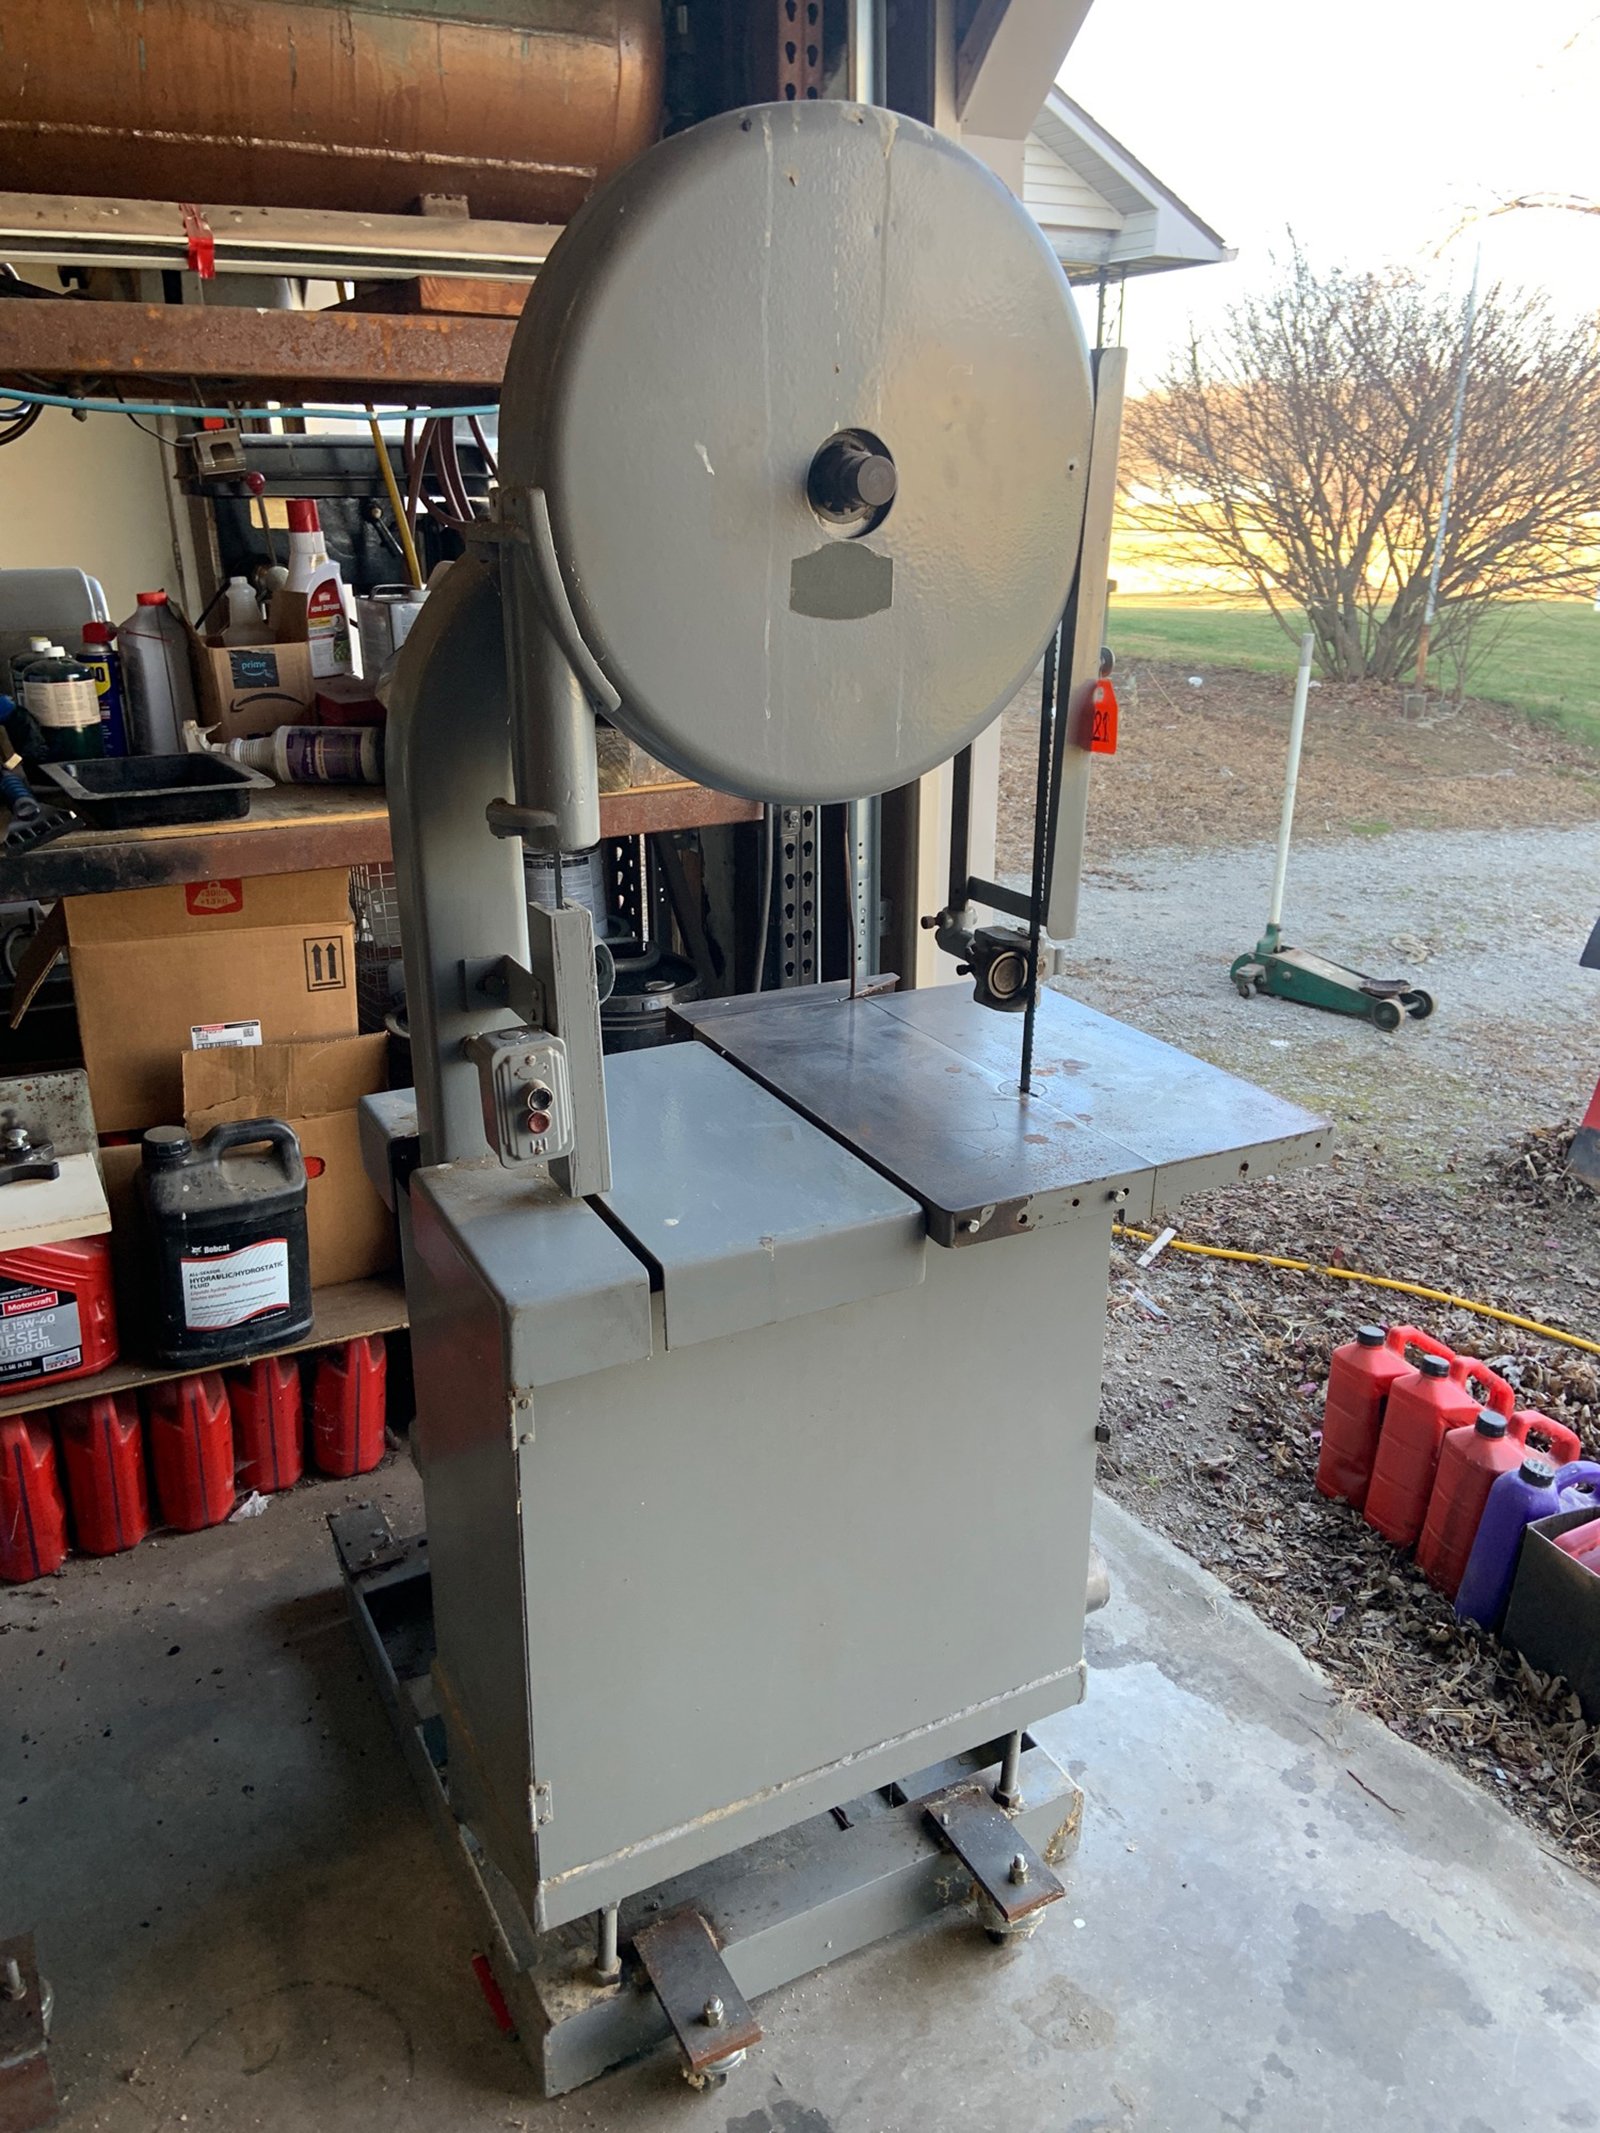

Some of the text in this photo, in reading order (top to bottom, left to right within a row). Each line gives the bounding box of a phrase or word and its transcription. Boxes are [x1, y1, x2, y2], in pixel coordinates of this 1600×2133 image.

[241, 660, 266, 670] prime
[204, 1243, 230, 1254] Bobcat
[190, 1282, 210, 1290] FLUID
[8, 1296, 53, 1312] Motorcraft
[0, 1313, 55, 1333] E 15W-40
[35, 1338, 55, 1351] OIL
